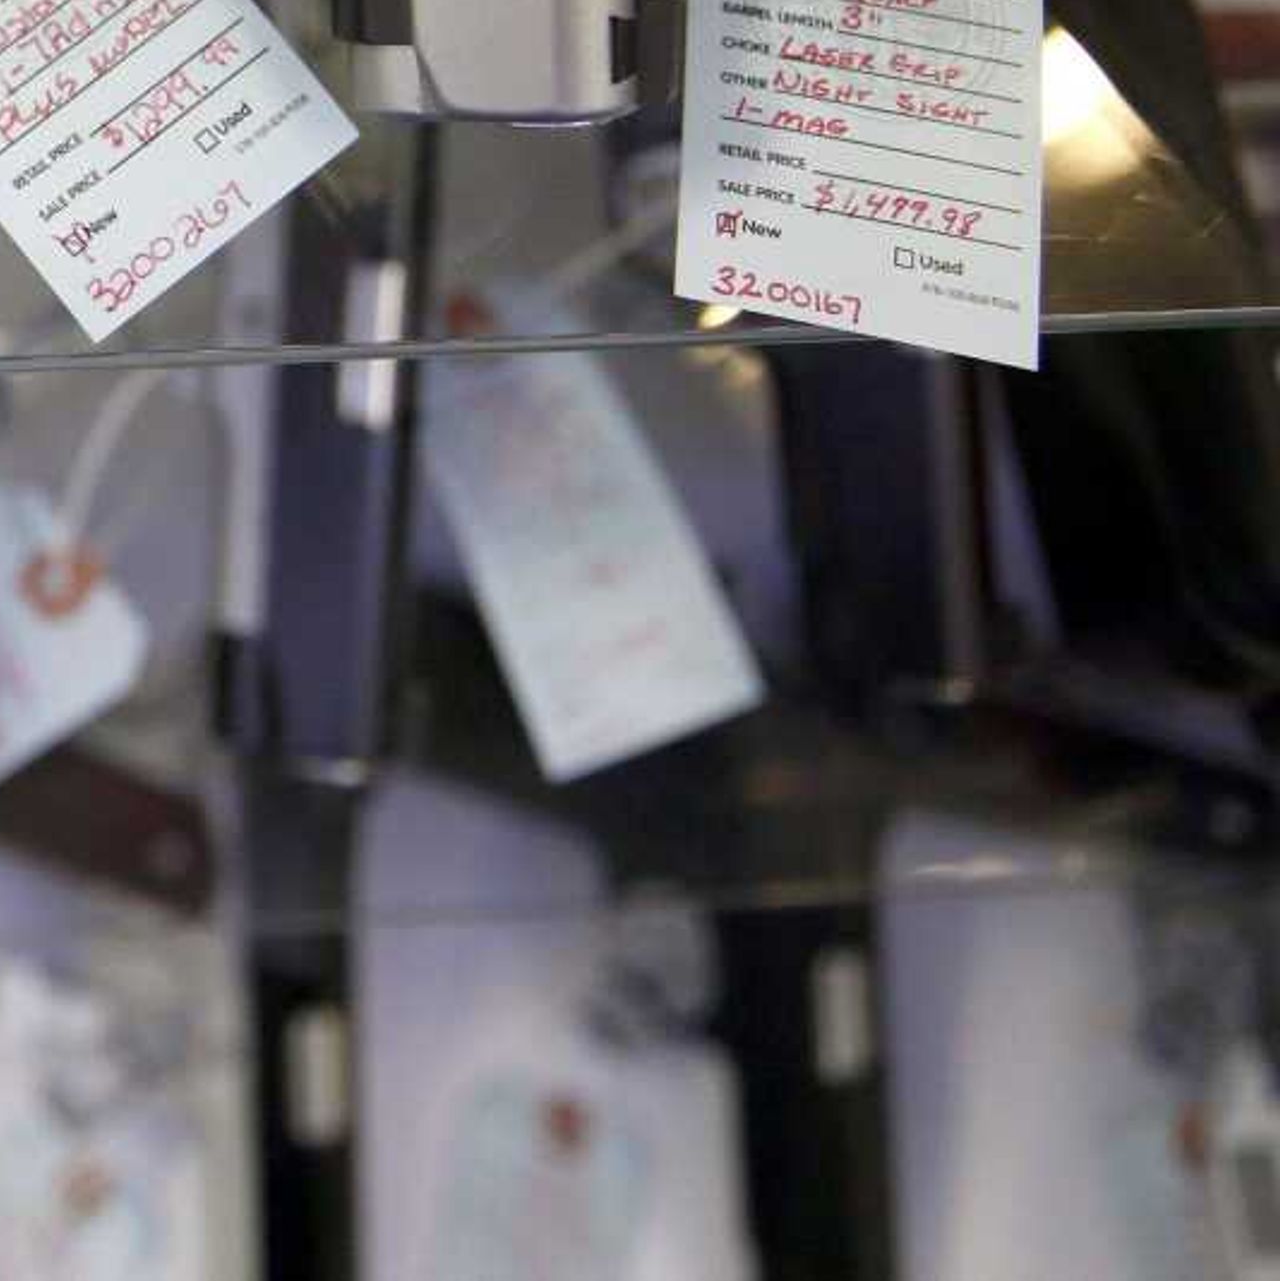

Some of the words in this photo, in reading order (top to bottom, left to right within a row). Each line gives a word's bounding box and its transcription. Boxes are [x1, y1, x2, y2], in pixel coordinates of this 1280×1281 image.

[721, 35, 771, 55] CHOKE
[720, 71, 768, 90] OTHER
[895, 92, 990, 125] SIGHT
[213, 101, 253, 136] Used
[49, 134, 80, 160] PRICE
[718, 142, 762, 163] RETAIL
[766, 150, 807, 171] PRICE
[39, 195, 68, 220] SALE
[67, 170, 101, 198] PRICE
[717, 178, 752, 196] SALE
[753, 185, 796, 206] PRICE
[742, 219, 782, 240] New
[918, 254, 964, 277] Used
[712, 265, 862, 325] 3200167
